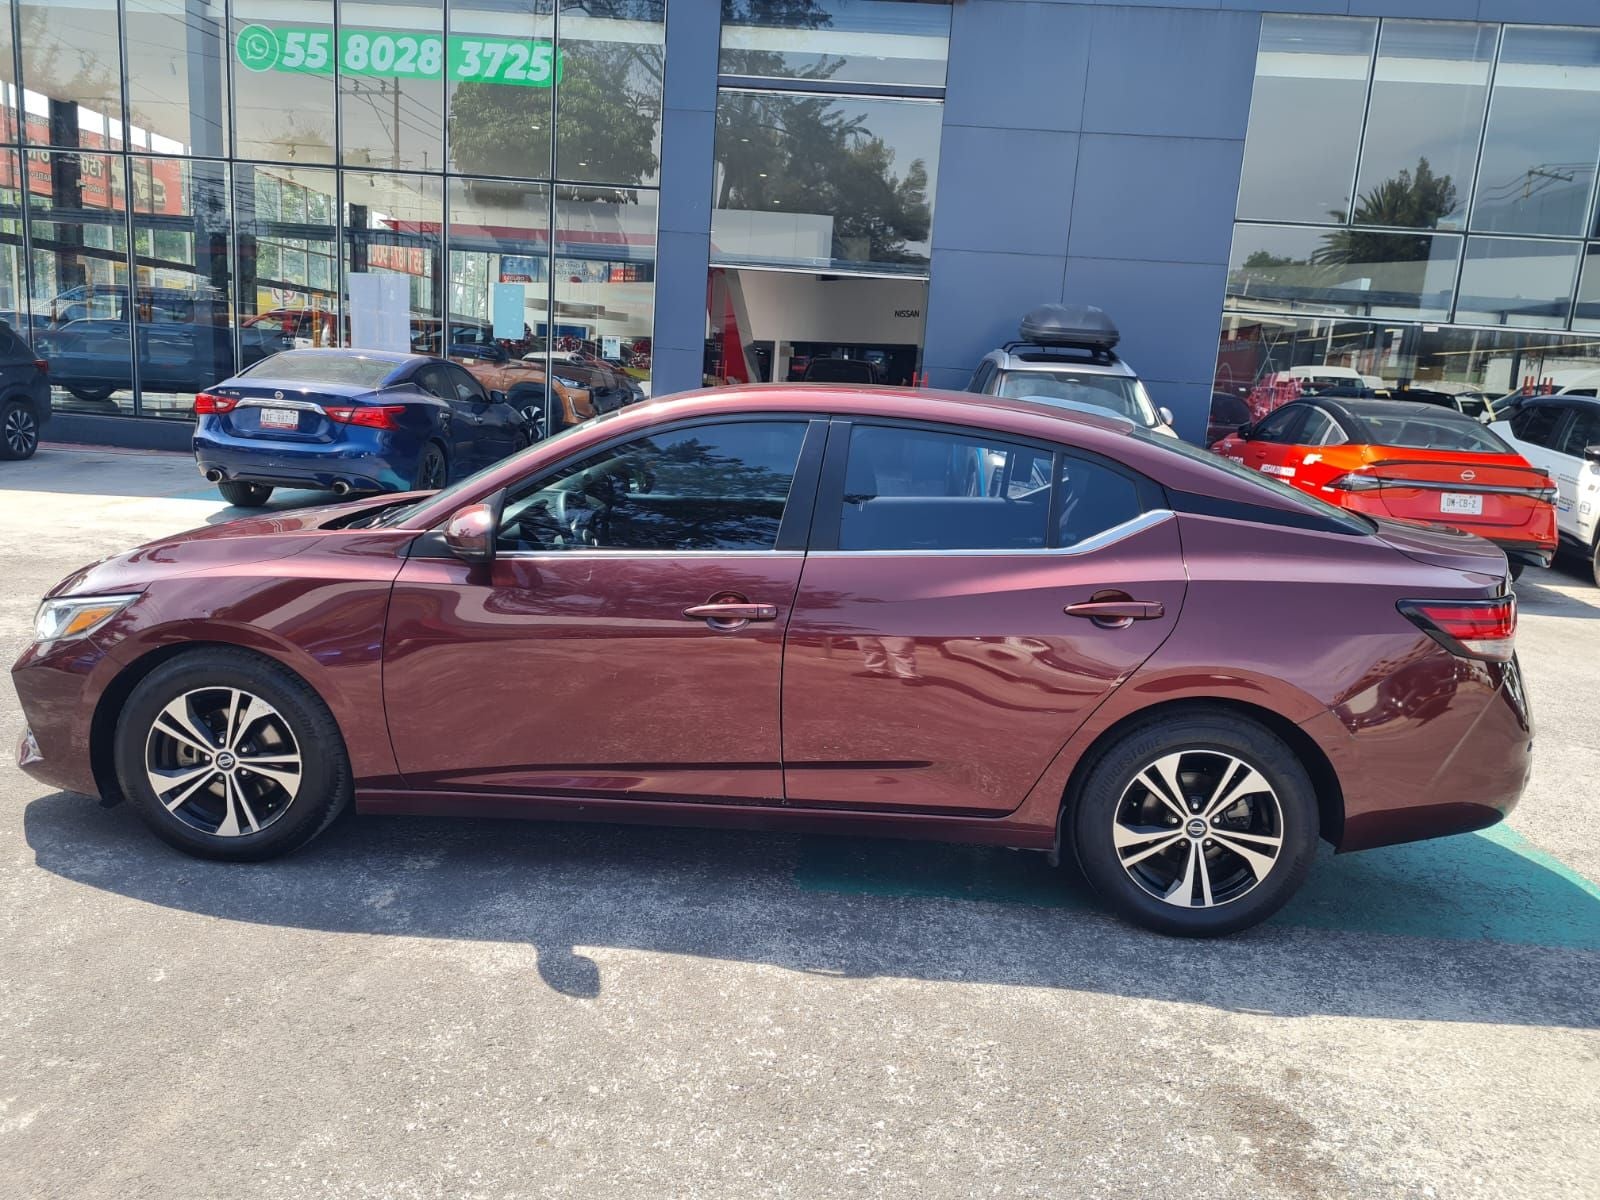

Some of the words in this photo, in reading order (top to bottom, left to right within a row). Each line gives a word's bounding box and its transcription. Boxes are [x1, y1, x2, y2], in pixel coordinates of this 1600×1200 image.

[282, 32, 329, 68] 55
[344, 34, 442, 75] 8028
[456, 41, 554, 82] 3725
[894, 309, 920, 318] NISSAN
